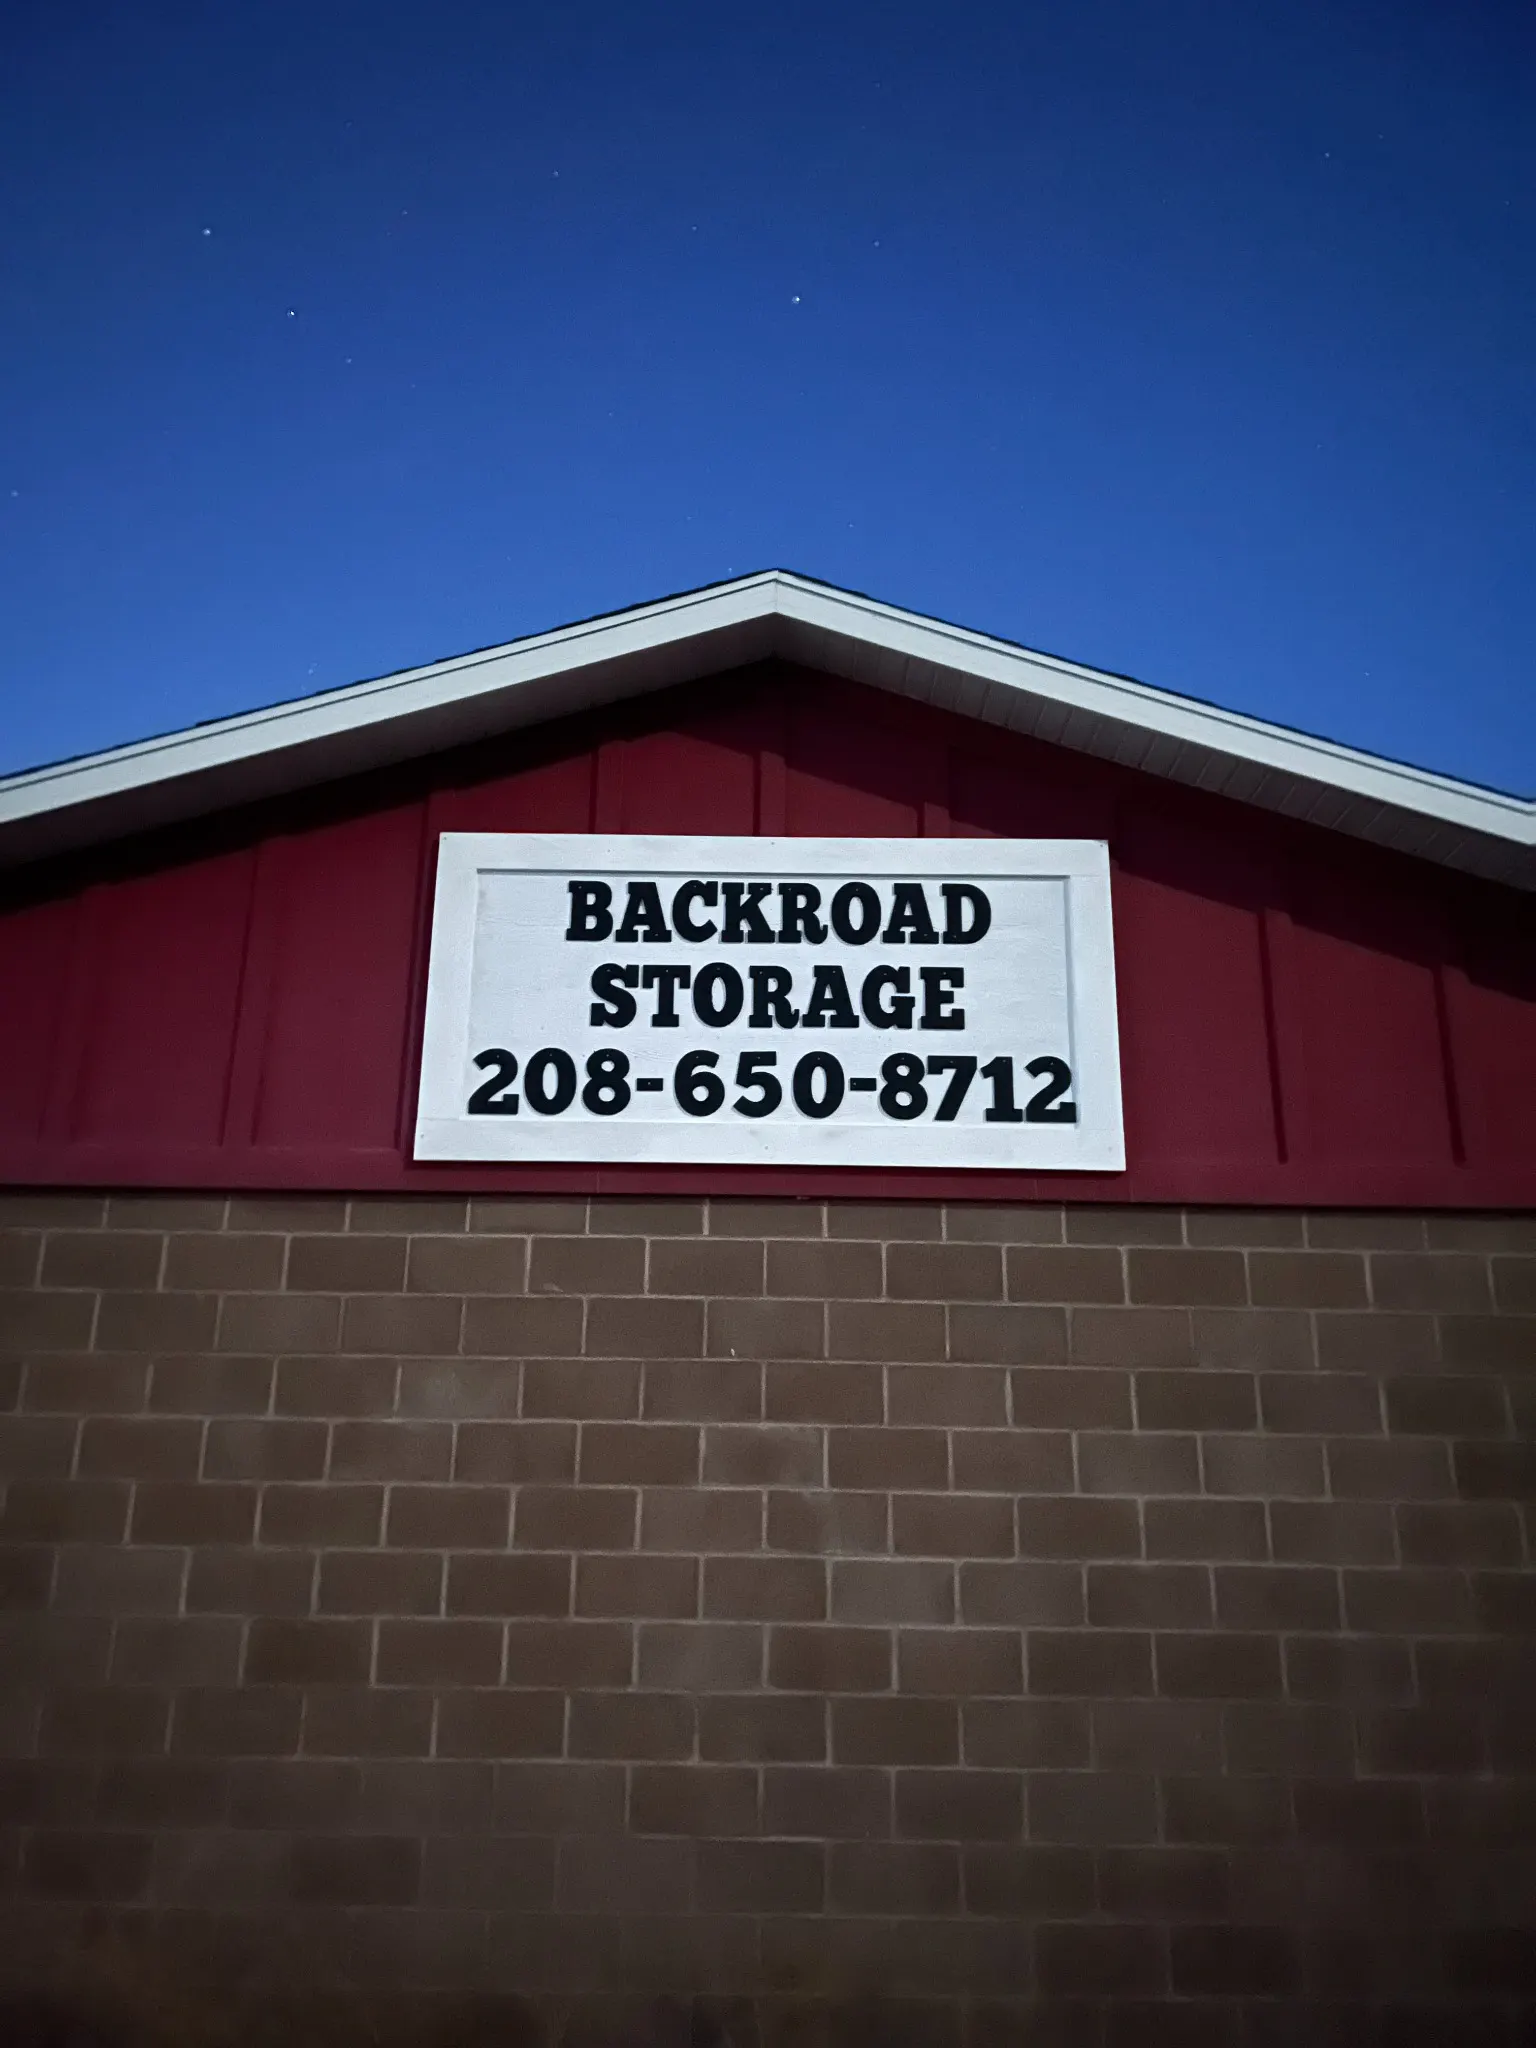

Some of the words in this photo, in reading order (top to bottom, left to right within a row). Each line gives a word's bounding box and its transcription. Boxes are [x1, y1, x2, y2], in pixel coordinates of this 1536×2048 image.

[565, 879, 992, 946] BACKROAD
[590, 962, 966, 1031] STORAGE
[467, 1047, 1078, 1124] 208-650-8712
